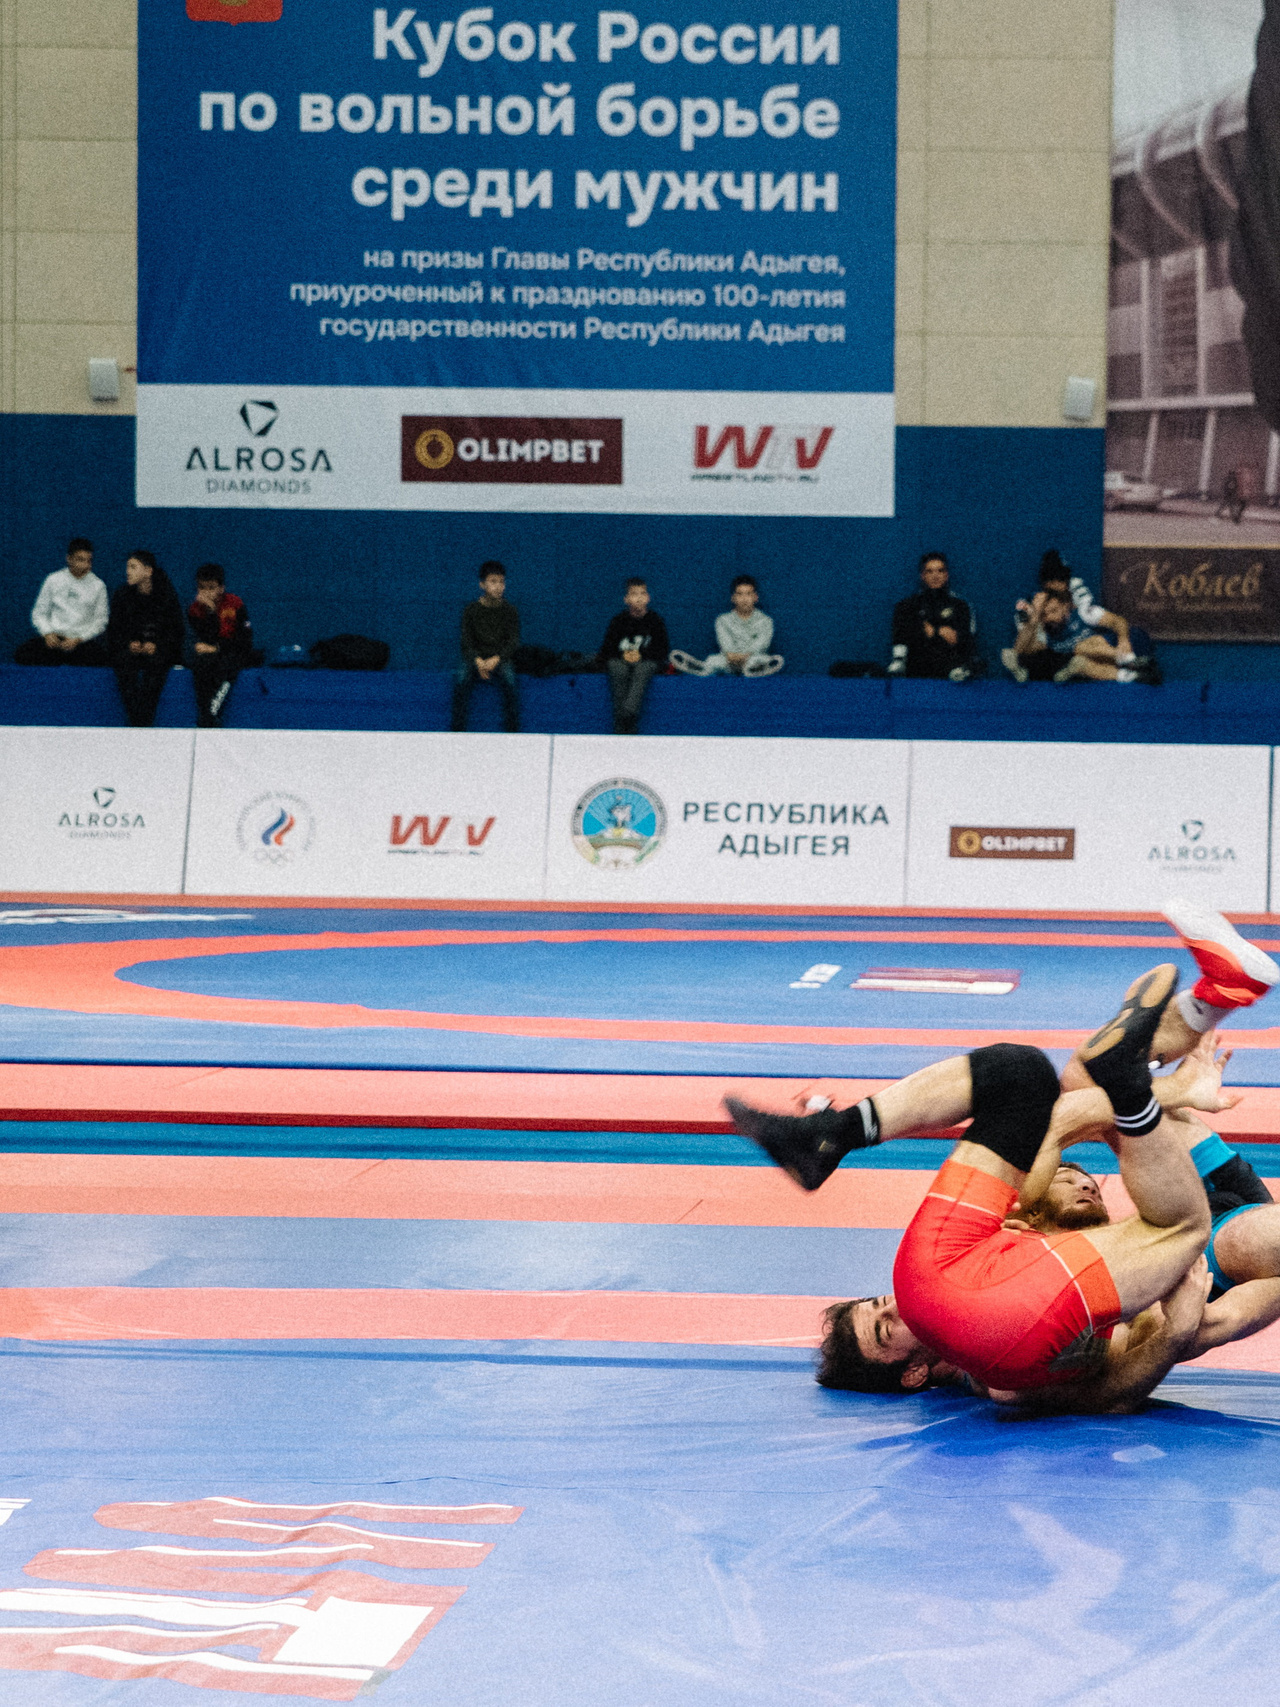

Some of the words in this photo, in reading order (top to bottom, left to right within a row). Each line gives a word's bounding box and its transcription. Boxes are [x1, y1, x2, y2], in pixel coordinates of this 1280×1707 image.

[373, 7, 576, 78] Кубок
[598, 11, 840, 65] России
[200, 92, 277, 132] по
[299, 82, 575, 136] вольной
[596, 82, 840, 151] борьбе
[352, 167, 553, 221] среди
[575, 170, 839, 227] мужчин
[363, 250, 395, 268] на
[401, 250, 484, 273] призы
[491, 246, 570, 270] Главы
[577, 248, 734, 275] Республики
[740, 250, 846, 276] Адыгея,
[290, 282, 484, 306] приуроченный
[490, 287, 505, 303] к
[512, 286, 706, 308] празднованию
[713, 284, 846, 308] 100-летия
[319, 317, 576, 342] государственности
[583, 318, 741, 345] Республики
[747, 320, 846, 344] Адыгея
[185, 446, 332, 473] ALROSA
[457, 437, 604, 464] OLIMPBET
[206, 478, 312, 494] DIAMONDS
[58, 812, 145, 828] ALROSA
[683, 802, 889, 825] РЕСПУБЛИКА
[717, 834, 850, 858] АДЫГЕЯ
